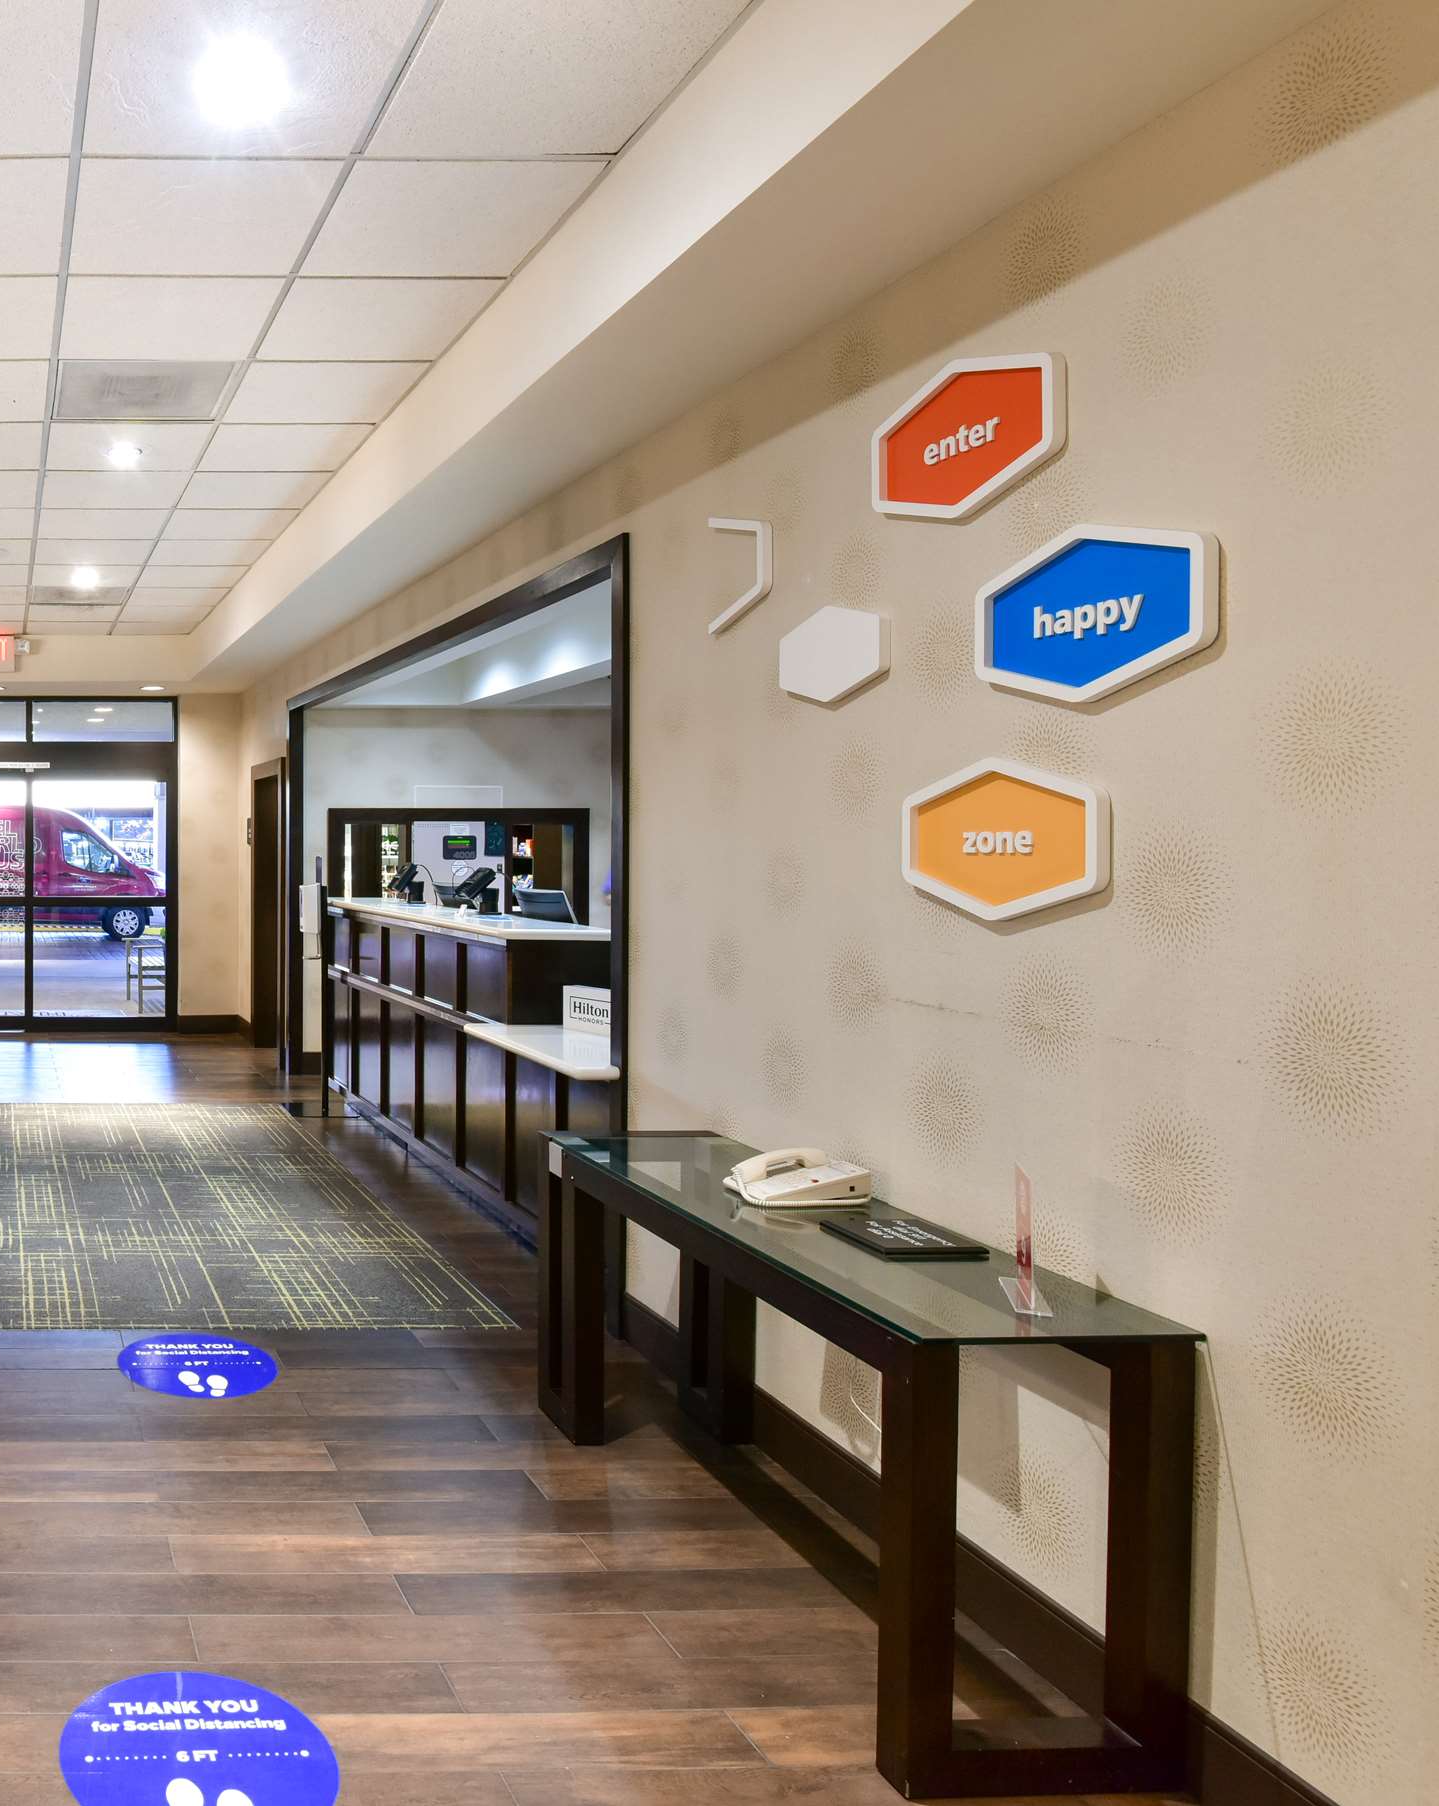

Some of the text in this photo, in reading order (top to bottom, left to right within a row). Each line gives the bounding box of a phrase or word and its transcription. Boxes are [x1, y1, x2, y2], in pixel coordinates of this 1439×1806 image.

[924, 416, 1001, 466] enter
[1033, 593, 1144, 640] happy
[962, 830, 1034, 855] zone
[573, 1001, 609, 1018] Hilton
[579, 1016, 604, 1025] HONORS
[108, 1699, 259, 1716] THANK YOU
[91, 1717, 287, 1733] for Social Distancing
[176, 1749, 219, 1762] 6 FT
